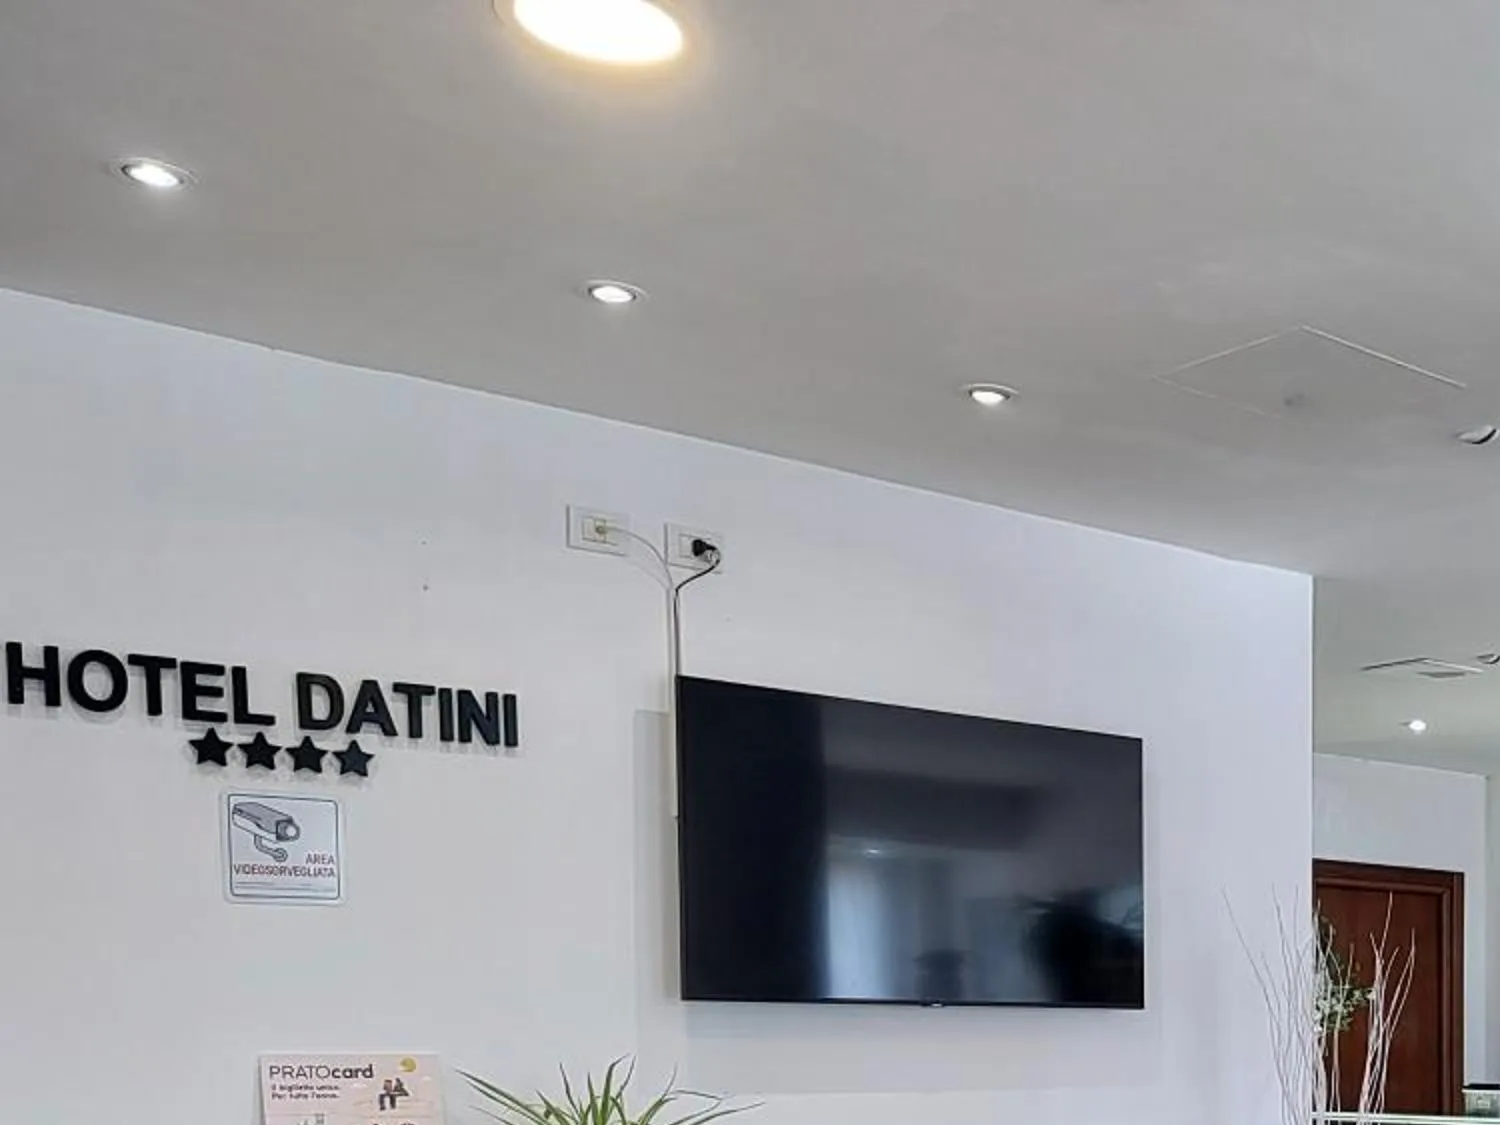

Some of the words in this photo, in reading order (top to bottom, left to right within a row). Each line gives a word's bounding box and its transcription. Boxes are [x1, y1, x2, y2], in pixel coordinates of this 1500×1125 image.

[6, 641, 276, 726] HOTEL
[296, 671, 518, 748] DATINI
[305, 853, 335, 865] AREA
[233, 863, 336, 878] VIDEOSORVEGLIATA
[269, 1064, 373, 1080] PRATOcard
